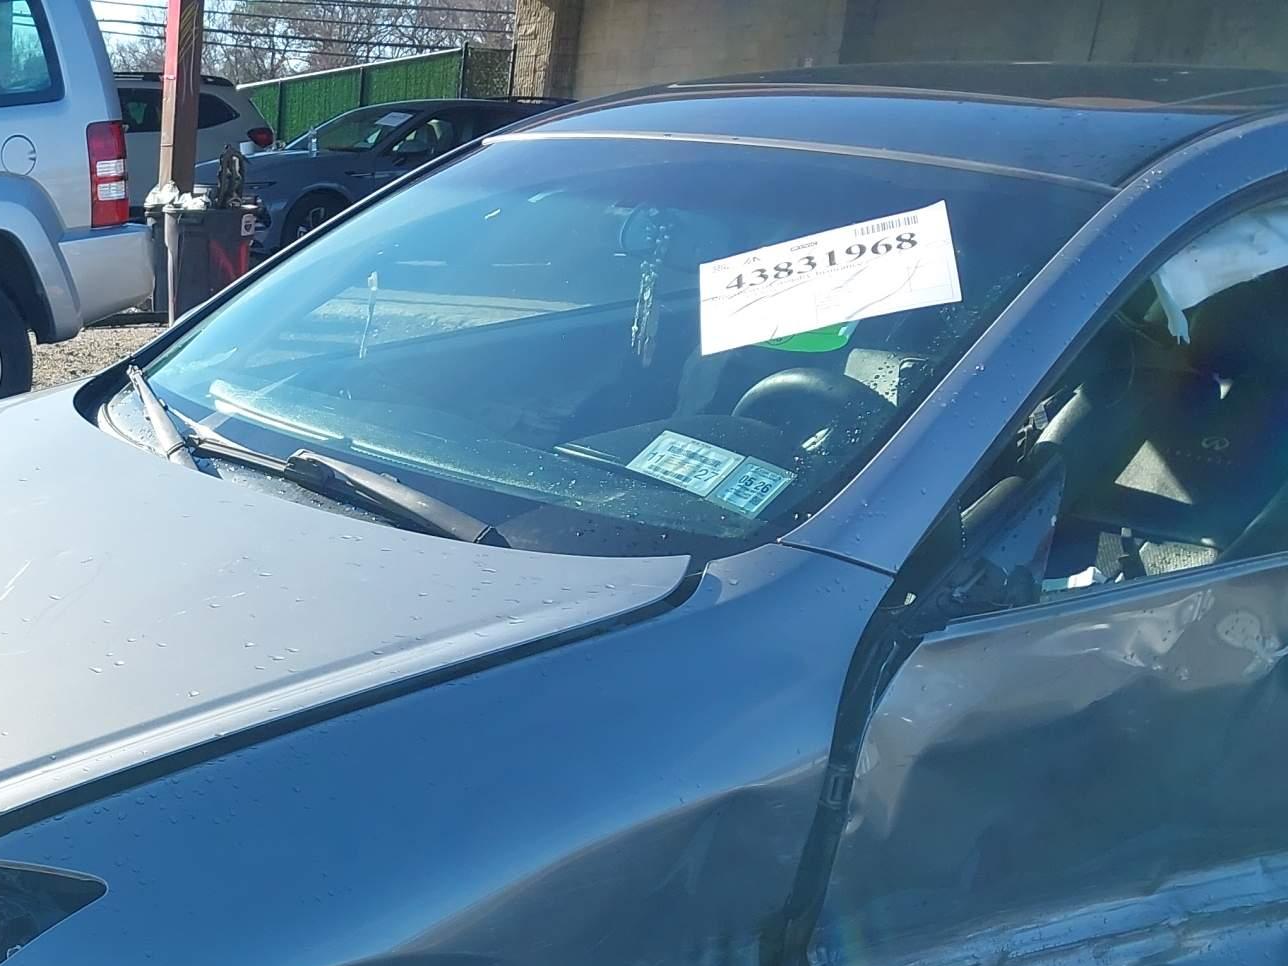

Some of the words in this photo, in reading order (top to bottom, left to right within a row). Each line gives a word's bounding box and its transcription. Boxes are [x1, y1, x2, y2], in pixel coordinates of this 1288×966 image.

[725, 231, 919, 291] 43831968
[693, 467, 720, 483] 27
[738, 474, 753, 488] 05
[753, 479, 773, 495] 26
